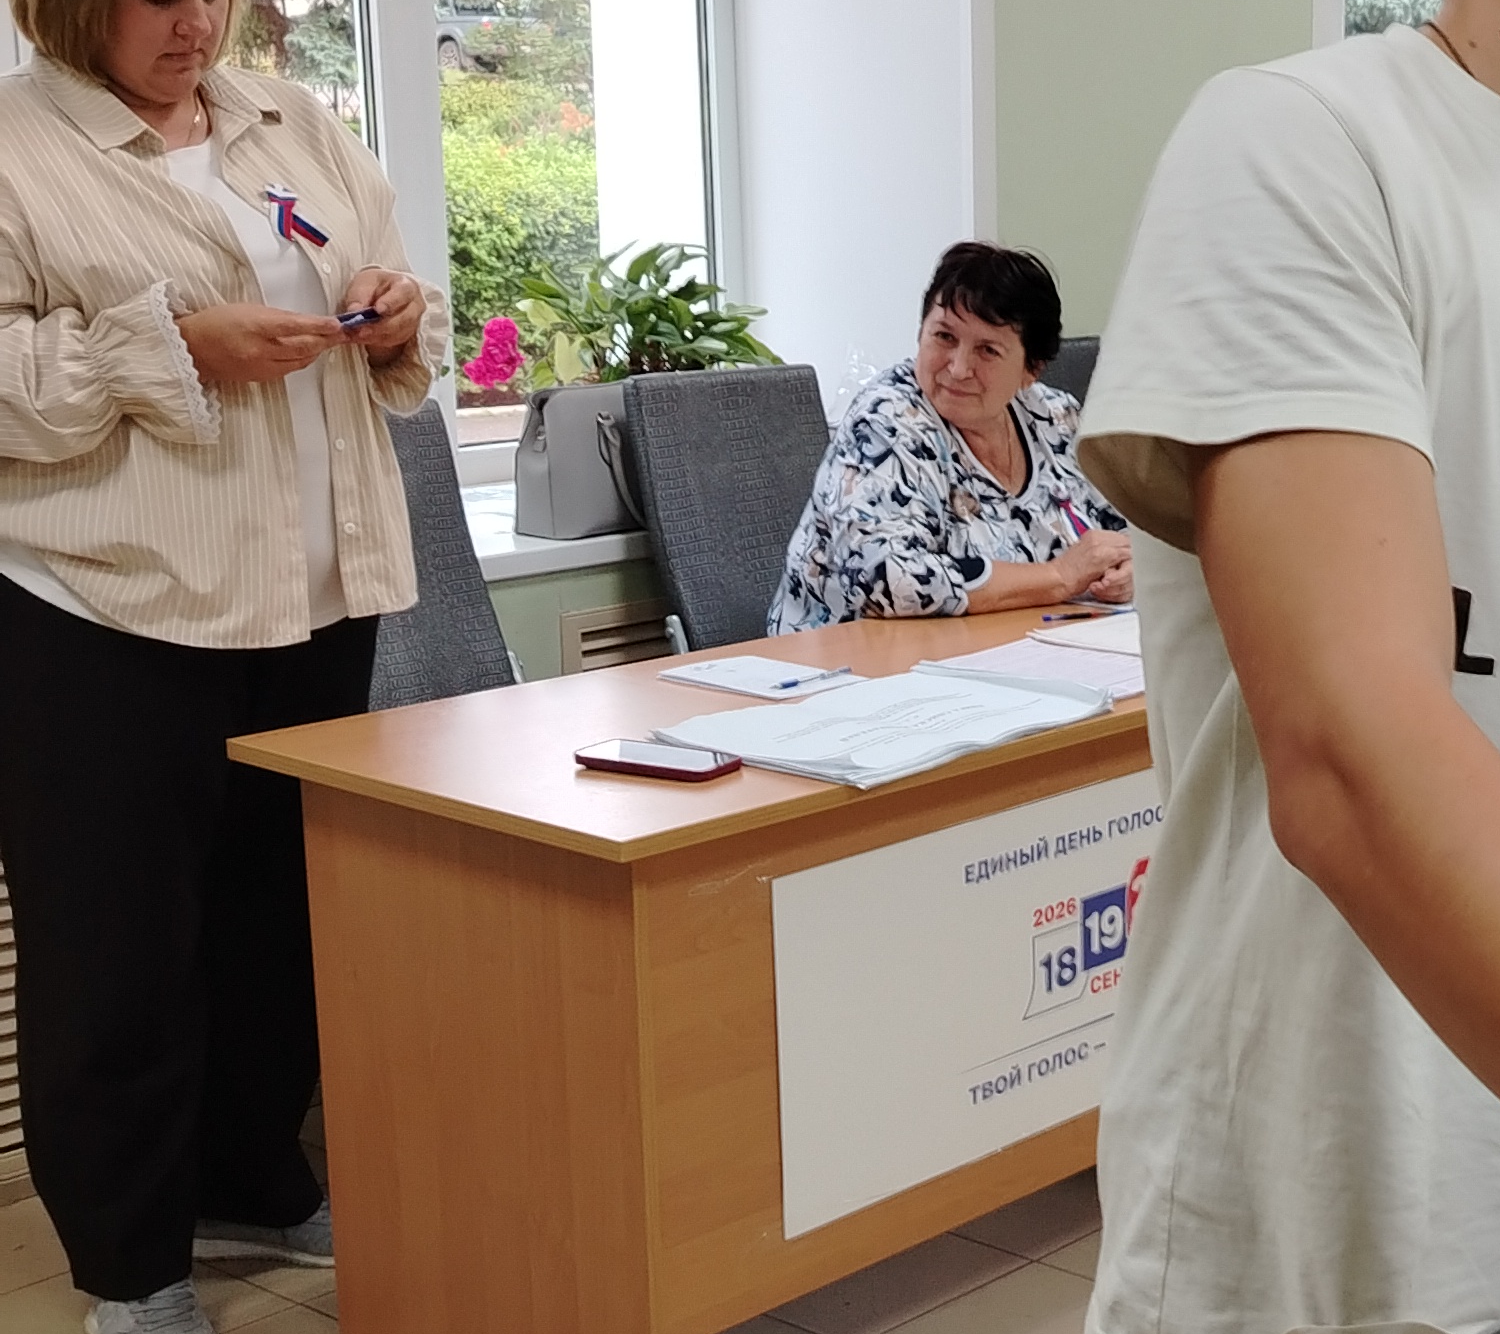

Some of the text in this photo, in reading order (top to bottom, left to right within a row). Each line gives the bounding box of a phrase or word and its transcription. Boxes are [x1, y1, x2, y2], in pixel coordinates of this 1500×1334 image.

[964, 804, 1165, 885] ЕДИНЫЙ ДЕНЬ ГОЛОС
[1032, 897, 1078, 928] 2026
[1039, 904, 1124, 994] 18 19
[1089, 966, 1124, 994] СЕН
[968, 1063, 1022, 1106] ТВОЙ
[1027, 1041, 1090, 1084] ГОЛОС
